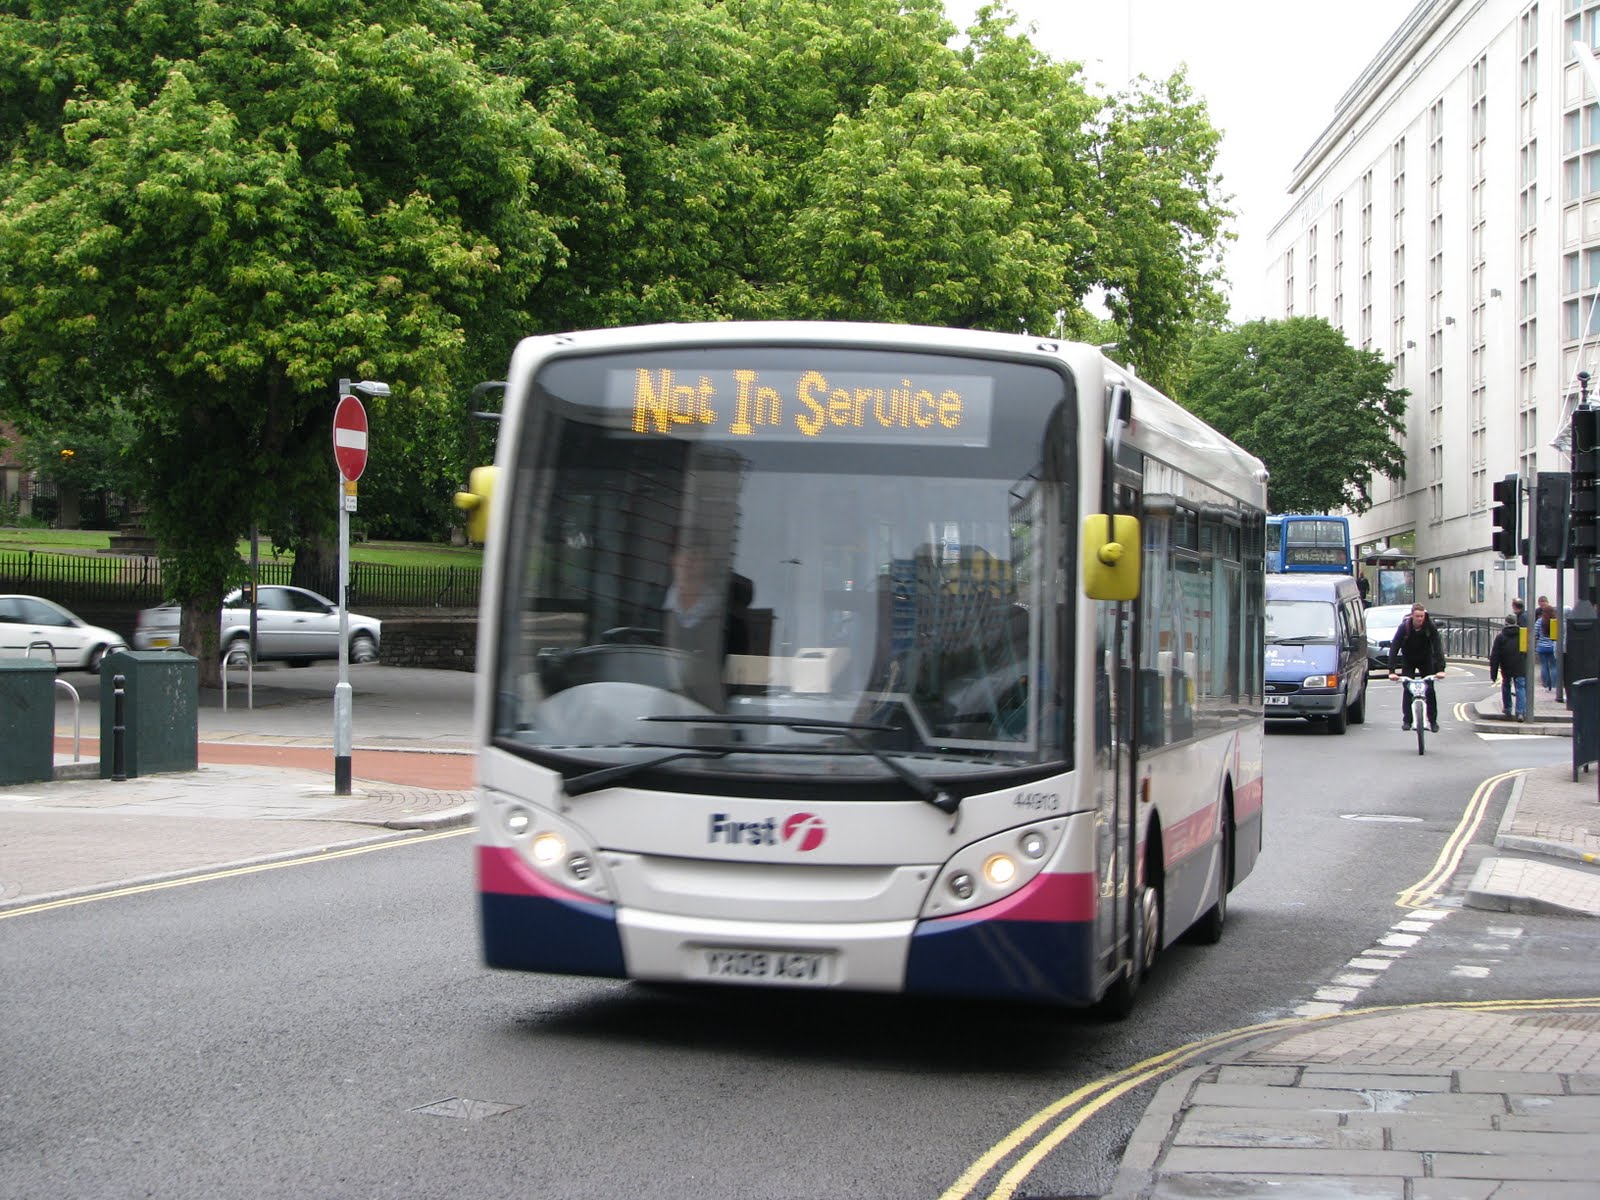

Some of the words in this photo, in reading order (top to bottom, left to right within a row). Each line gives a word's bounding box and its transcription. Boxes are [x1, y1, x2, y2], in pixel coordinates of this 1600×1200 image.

[632, 367, 717, 433] Not
[728, 368, 783, 435] In
[795, 370, 965, 436] Service
[1014, 792, 1060, 811] 44913
[708, 812, 777, 845] First
